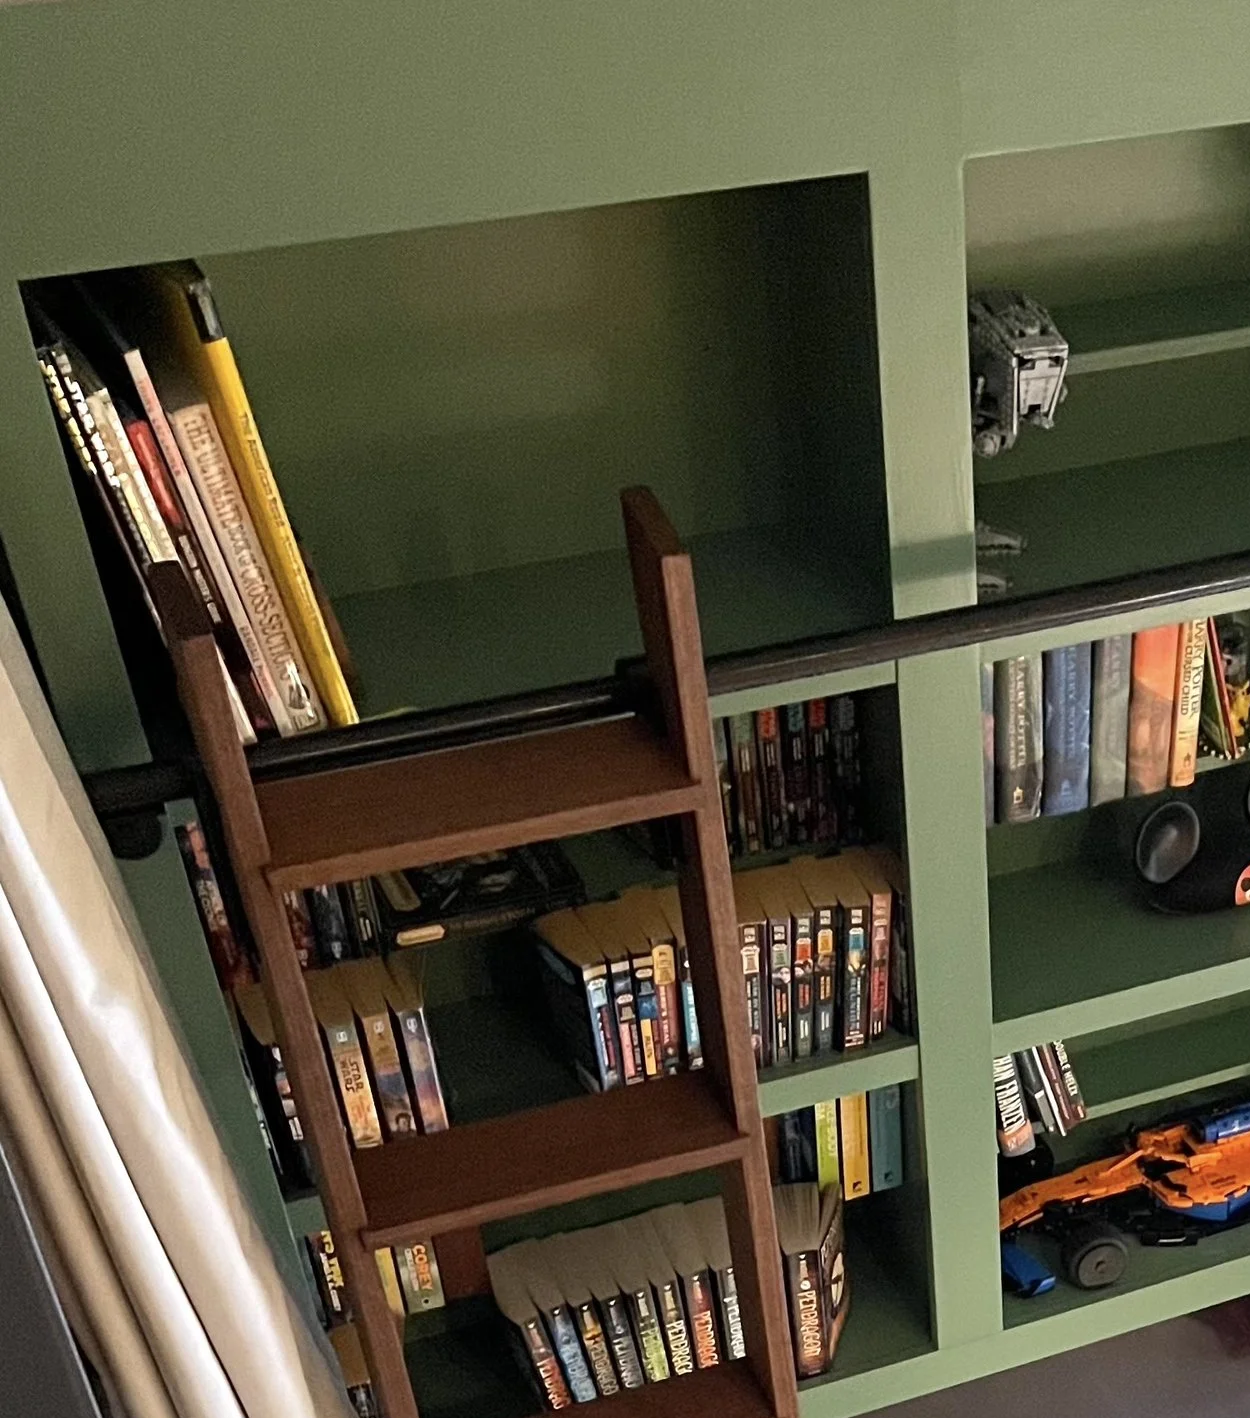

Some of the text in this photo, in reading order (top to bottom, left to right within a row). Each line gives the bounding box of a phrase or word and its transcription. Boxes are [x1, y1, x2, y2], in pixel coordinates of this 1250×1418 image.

[63, 373, 98, 434] STAR
[183, 413, 215, 451] THE
[194, 444, 241, 530] ULTIMATE
[1180, 645, 1193, 715] CURSED CHILD
[1189, 619, 1206, 718] HARRY POTTER
[1017, 714, 1028, 767] POTTER
[338, 1059, 355, 1094] WARS
[347, 1054, 364, 1092] STAR
[1063, 1070, 1078, 1097] HELIX
[994, 1079, 1027, 1135] FRANZEN
[411, 1243, 434, 1292] COREY
[795, 1289, 824, 1358] PENDRAGON
